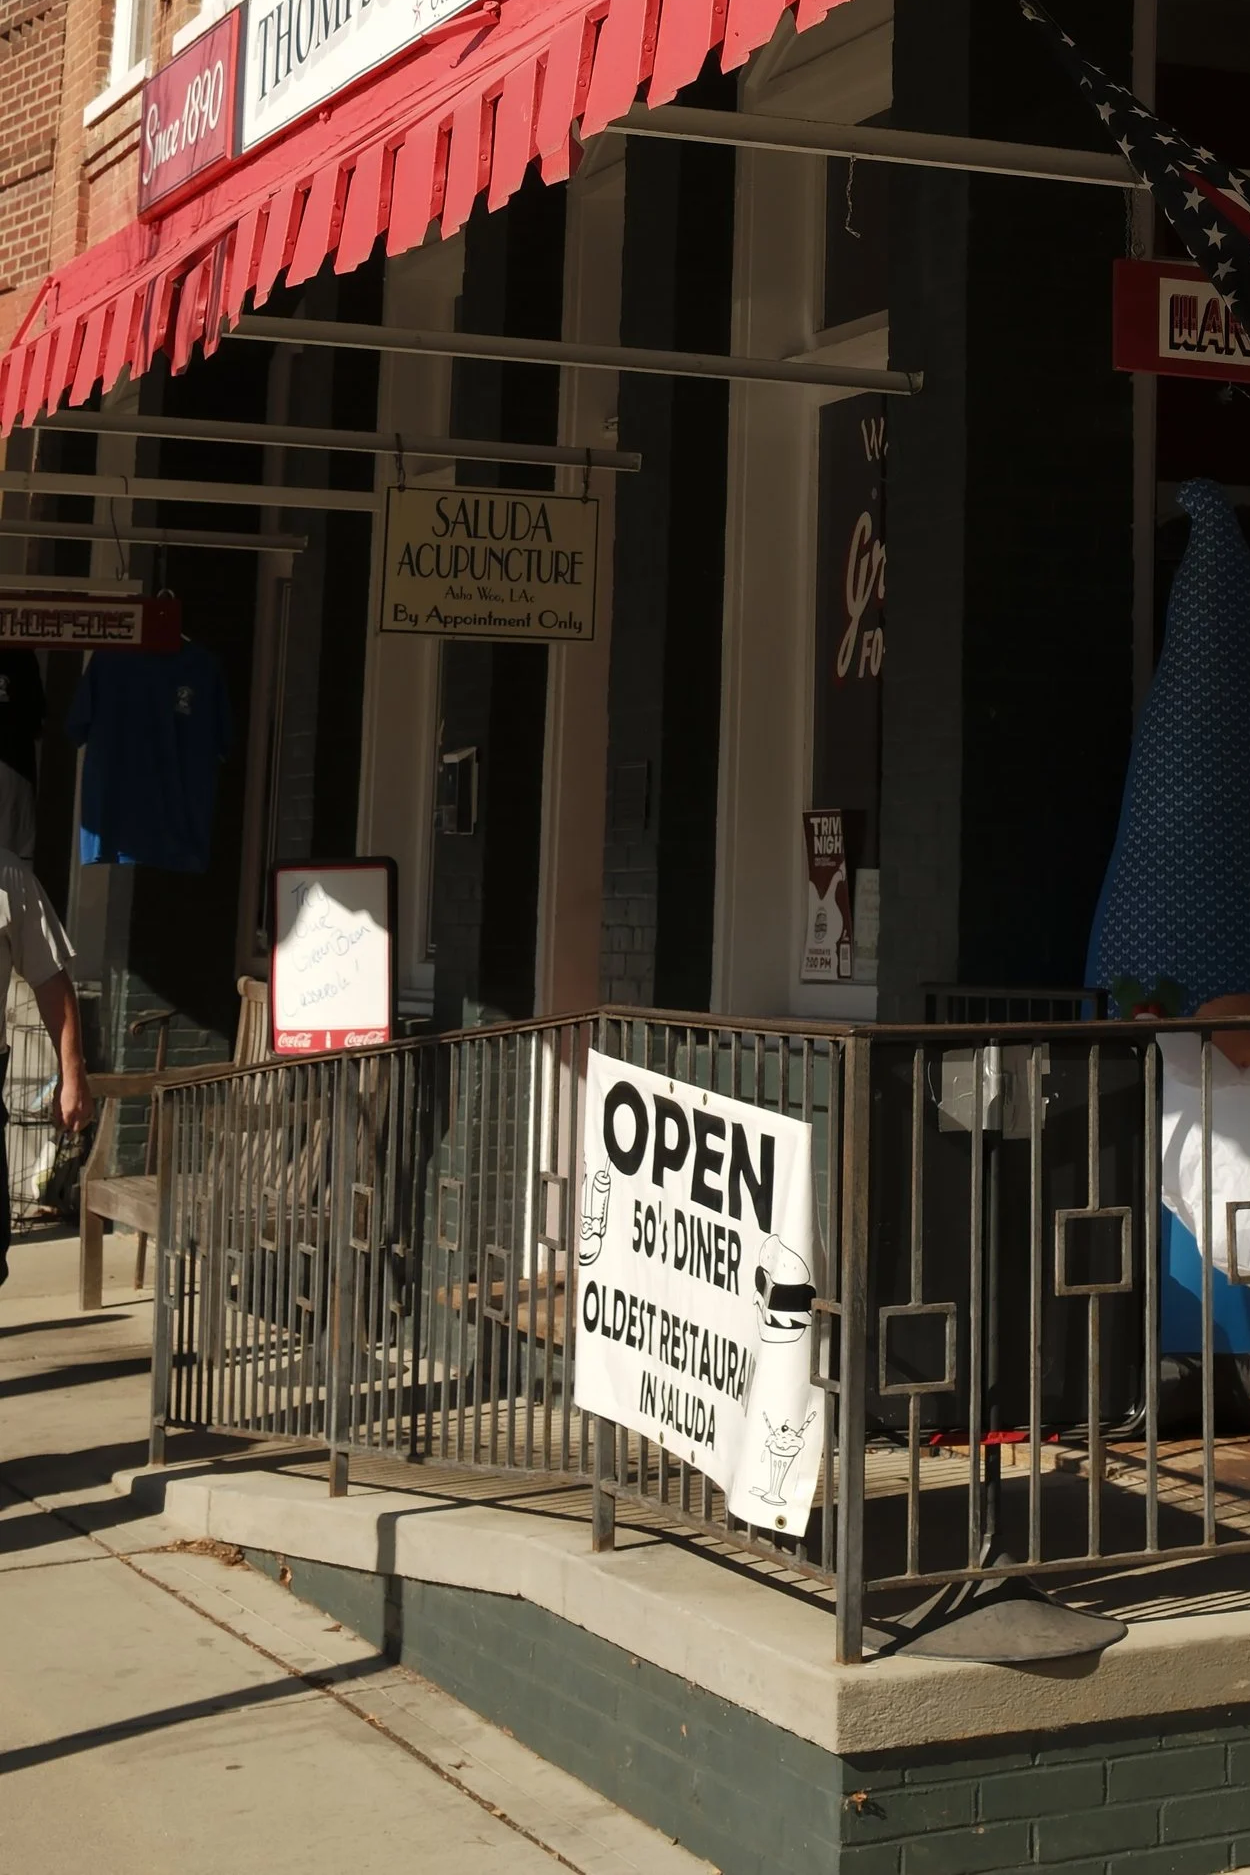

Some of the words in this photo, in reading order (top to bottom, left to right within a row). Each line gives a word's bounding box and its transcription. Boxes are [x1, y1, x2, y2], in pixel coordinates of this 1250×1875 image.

[143, 94, 179, 186] Since
[180, 60, 224, 154] 1890
[861, 417, 889, 462] W
[432, 496, 553, 543] SALUDA
[397, 542, 584, 585] ACUPUNCTURE
[445, 586, 472, 601] Asha
[393, 603, 419, 627] By
[425, 605, 532, 629] Appointment
[538, 610, 583, 634] Only
[857, 627, 886, 679] FO
[814, 835, 844, 855] NIGH
[603, 1080, 776, 1234] OPEN
[673, 1207, 742, 1296] DINER
[583, 1280, 656, 1352] OLDEST
[639, 1370, 656, 1419] IN
[659, 1381, 716, 1451] SALUDA
